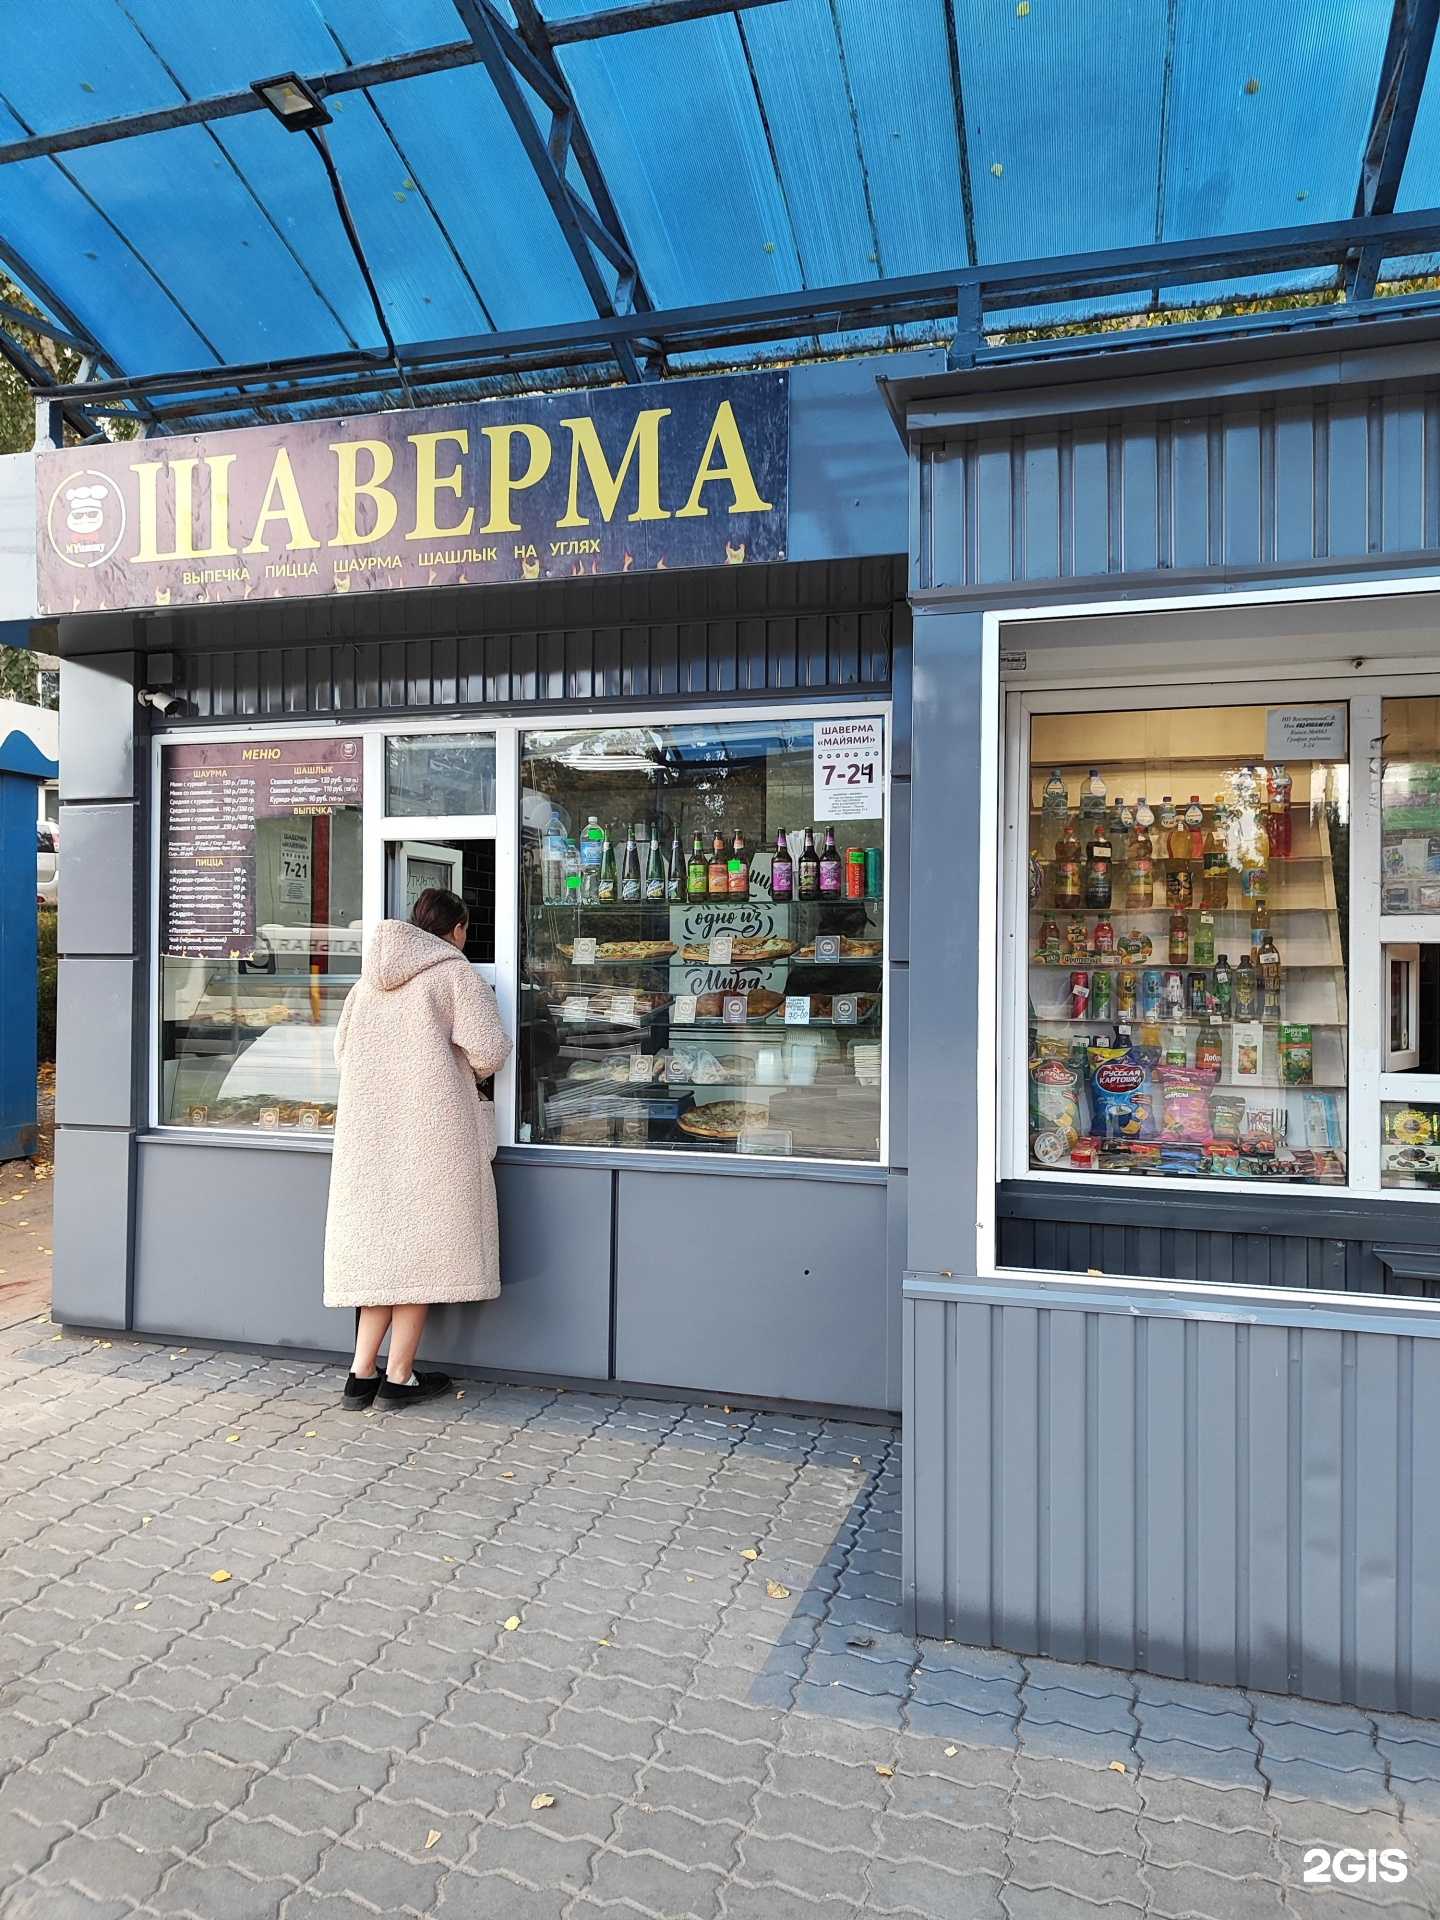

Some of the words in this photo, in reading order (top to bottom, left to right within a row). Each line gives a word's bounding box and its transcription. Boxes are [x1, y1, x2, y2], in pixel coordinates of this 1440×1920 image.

[129, 400, 772, 563] ШАВЕРМА
[183, 567, 250, 584] ВЫПЕЧКА
[265, 562, 319, 578] ПИЦЦА
[333, 555, 402, 573] ШАУРМА
[418, 548, 497, 565] ШАШЛЫК
[514, 545, 537, 558] НА
[550, 539, 600, 557] УГЛЯХ
[822, 725, 873, 735] ШАВЕРМА
[818, 736, 875, 747] «МАЙЯМИ»
[242, 748, 281, 760] МЕНЮ
[193, 769, 227, 778] ШАУРМА
[293, 766, 333, 775] ШАШЛЫК
[293, 807, 333, 815] ВЫПЕЧКА
[195, 858, 224, 867] ПИЦЦА
[284, 861, 307, 878] 7-21
[694, 912, 737, 939] одно
[691, 967, 760, 995] Мира
[1102, 1069, 1141, 1077] РУССКАЯ
[1099, 1076, 1142, 1085] КАРТОШКА
